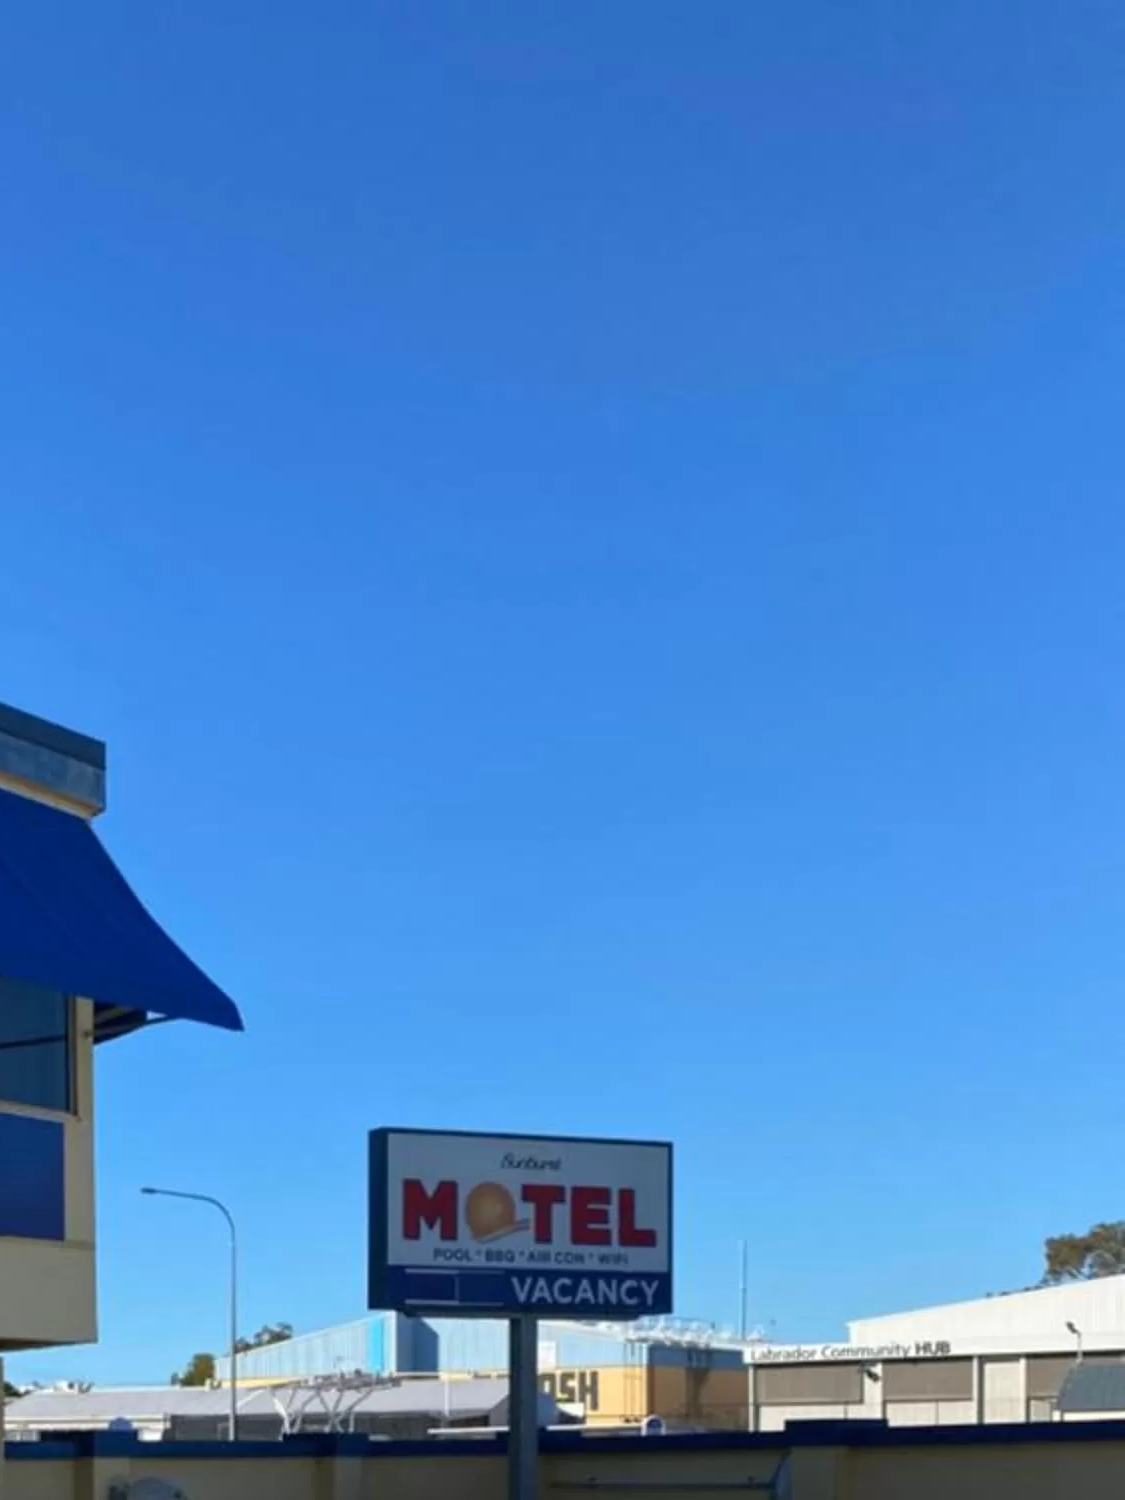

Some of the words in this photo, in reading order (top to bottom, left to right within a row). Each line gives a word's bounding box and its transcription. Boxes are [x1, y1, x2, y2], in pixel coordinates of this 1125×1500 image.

[402, 1178, 657, 1248] MOTEL
[433, 1248, 472, 1262] POOL
[485, 1249, 515, 1263] BBQ
[511, 1276, 659, 1305] VACANCY
[751, 1347, 816, 1362] Labrador
[821, 1344, 911, 1362] Community
[914, 1339, 951, 1356] HUB
